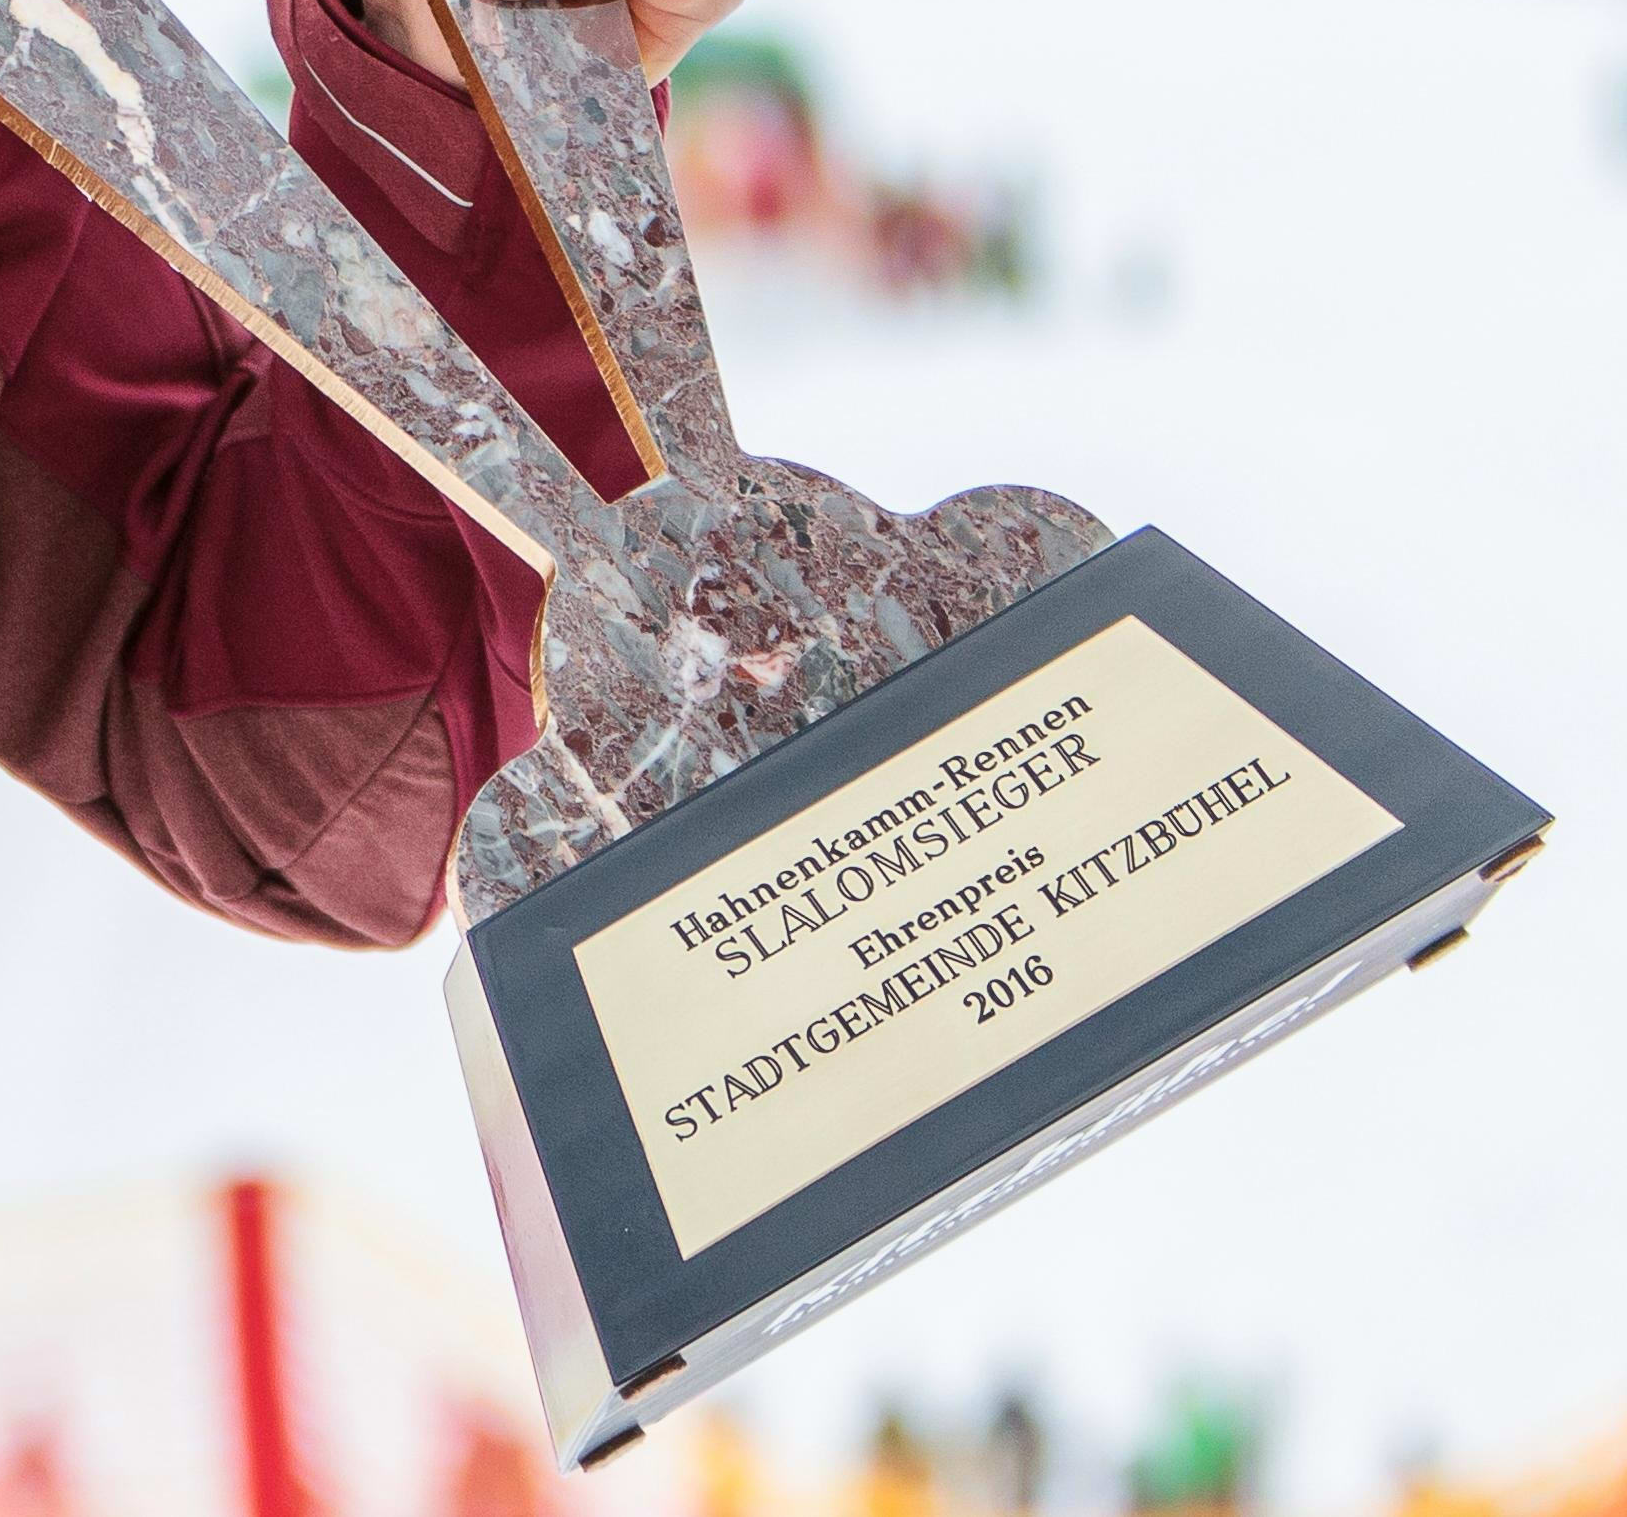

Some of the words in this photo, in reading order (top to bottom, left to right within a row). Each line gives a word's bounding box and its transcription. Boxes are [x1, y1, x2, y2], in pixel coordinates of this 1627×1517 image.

[669, 695, 1093, 952] Hahnenkamm-Rennen
[714, 732, 1101, 979] SLALOMSIEGER
[847, 843, 1045, 970] Ehrenpreis
[664, 903, 1035, 1143] STADTGEMEINDE
[1037, 756, 1292, 919] KITZBÜHEL
[962, 954, 1054, 1025] 2016
